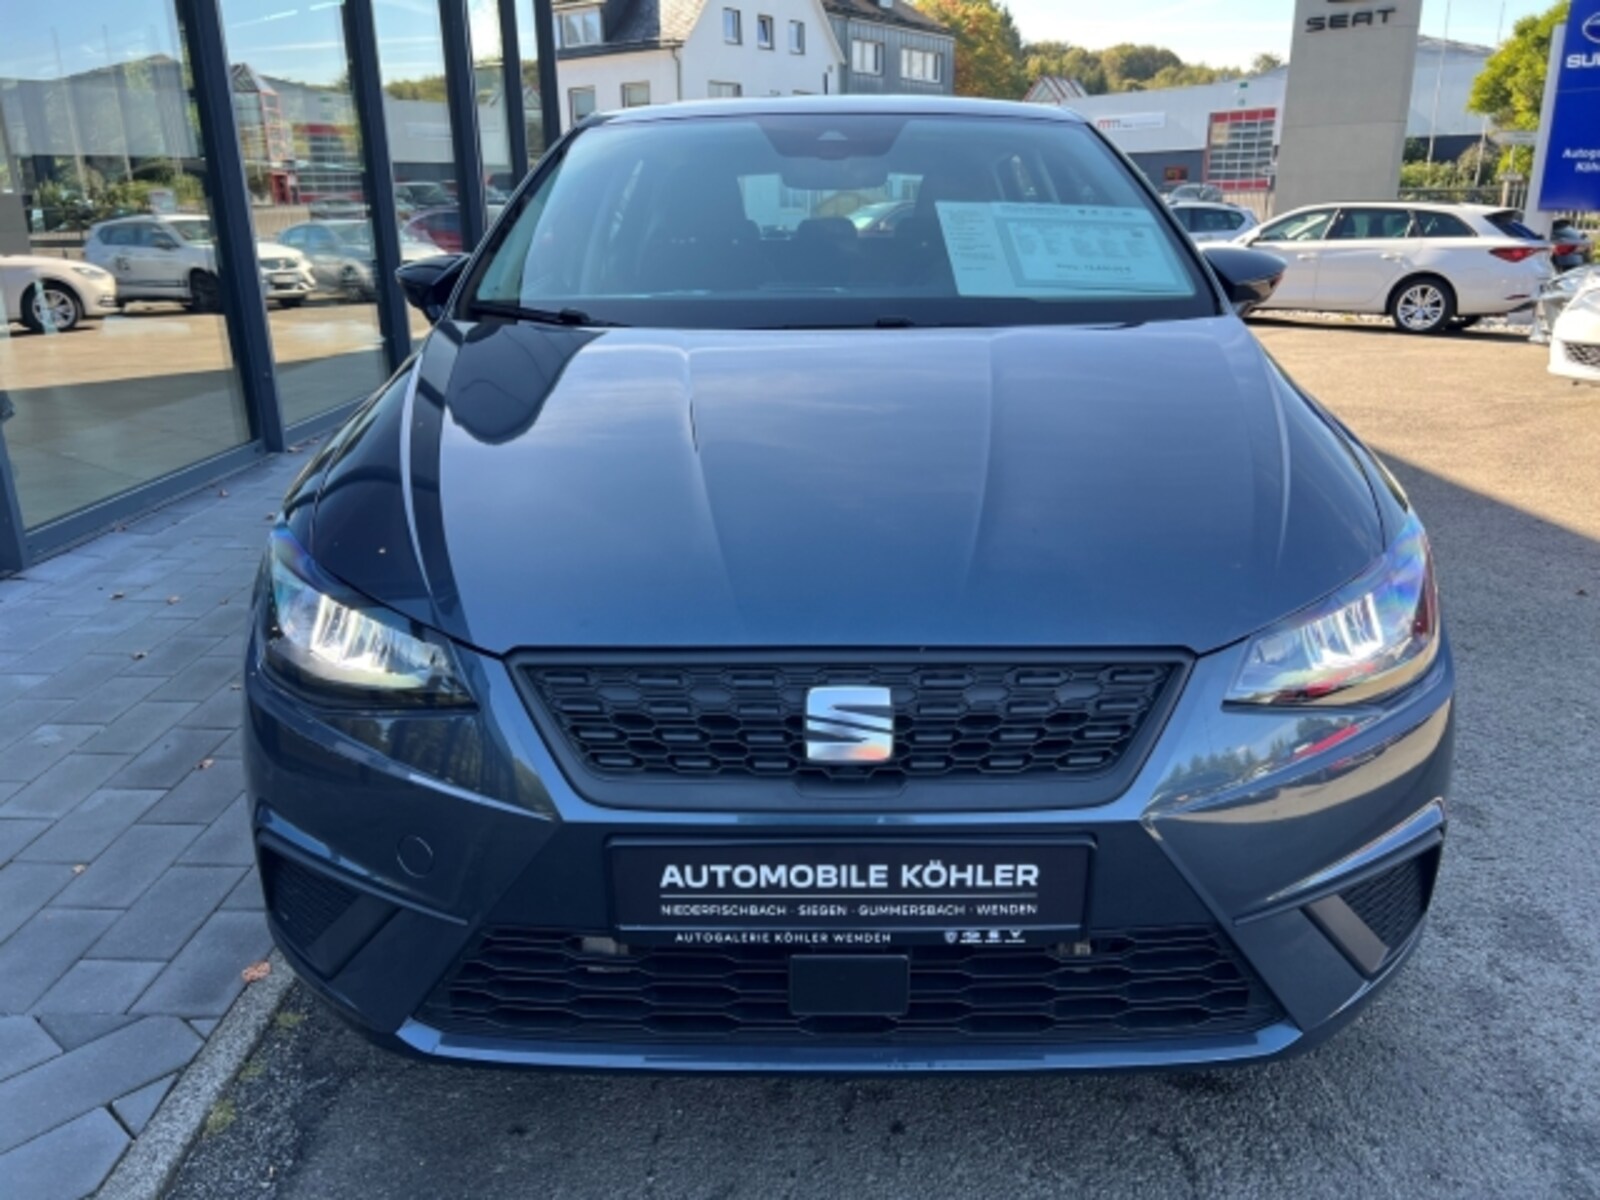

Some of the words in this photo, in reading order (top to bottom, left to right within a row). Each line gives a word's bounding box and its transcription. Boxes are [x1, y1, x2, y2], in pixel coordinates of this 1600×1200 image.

[1305, 7, 1396, 33] SEAT
[1566, 53, 1600, 68] SU
[660, 864, 889, 889] AUTOMOBILE
[901, 859, 1040, 888] KÖHLER
[661, 904, 787, 917] NIEDERFISCHBACH
[797, 904, 848, 917] SIEGEN
[857, 904, 967, 917] GUMMERSBACH
[975, 903, 1038, 916] WENDEN
[674, 932, 771, 944] AUTOGALERIE
[774, 931, 829, 944] KÖHLER
[833, 931, 892, 944] WENDEN
